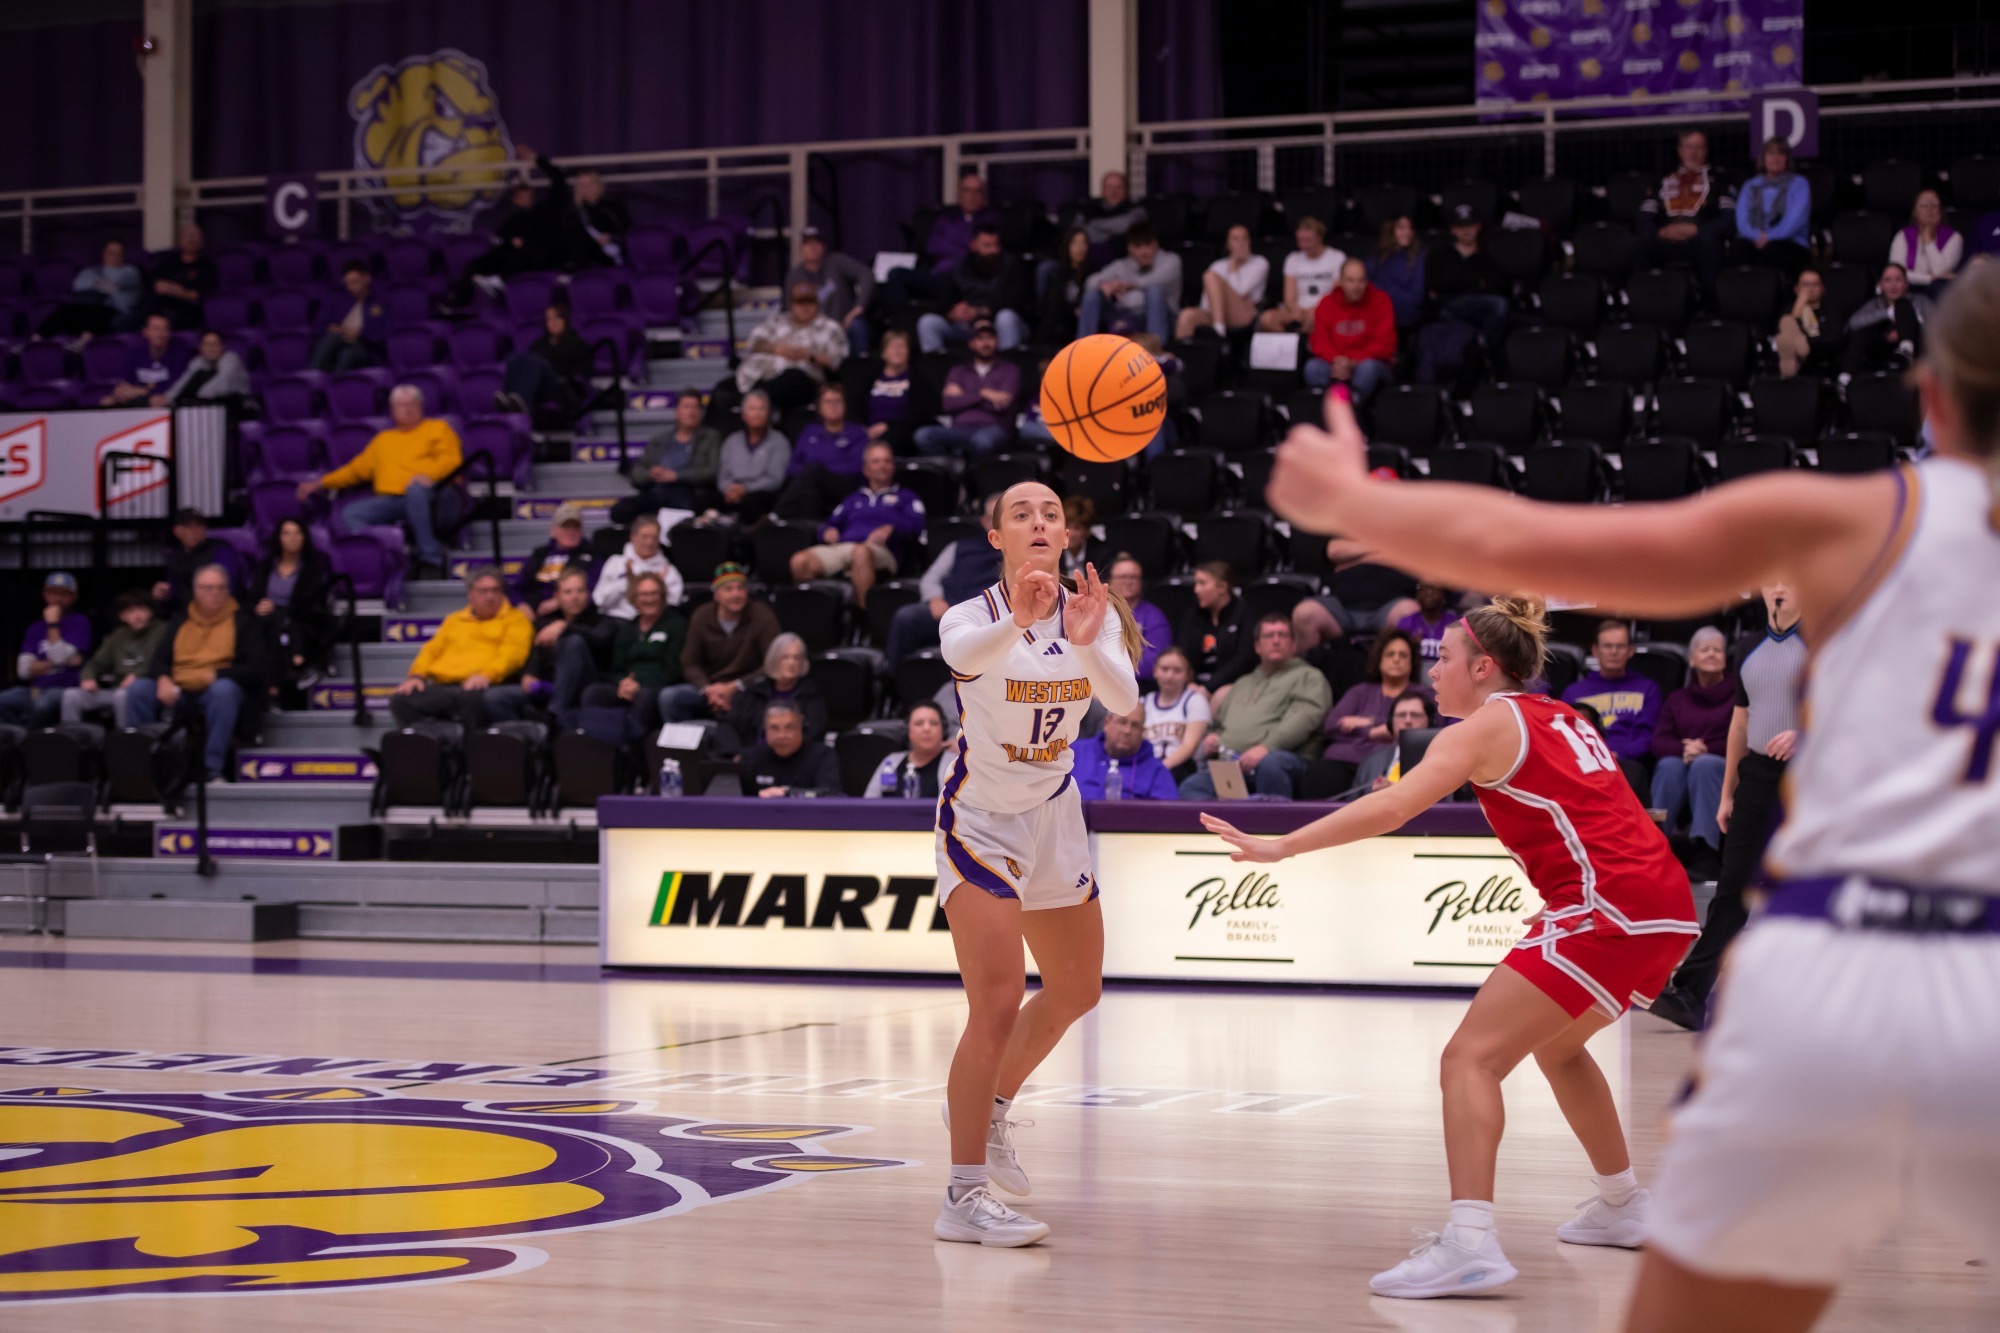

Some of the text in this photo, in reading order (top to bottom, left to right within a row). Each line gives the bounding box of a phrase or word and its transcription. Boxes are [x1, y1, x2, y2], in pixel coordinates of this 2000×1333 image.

[1762, 97, 1806, 148] D
[273, 181, 309, 229] C
[1004, 677, 1091, 703] WESTERN
[1926, 632, 2000, 788] 4
[1029, 707, 1065, 745] 13
[1185, 871, 1281, 931] Pella
[1424, 874, 1525, 936] Pella
[1226, 920, 1270, 930] FAMILY
[1226, 932, 1278, 943] BRANDS
[1468, 925, 1512, 935] FAMILY
